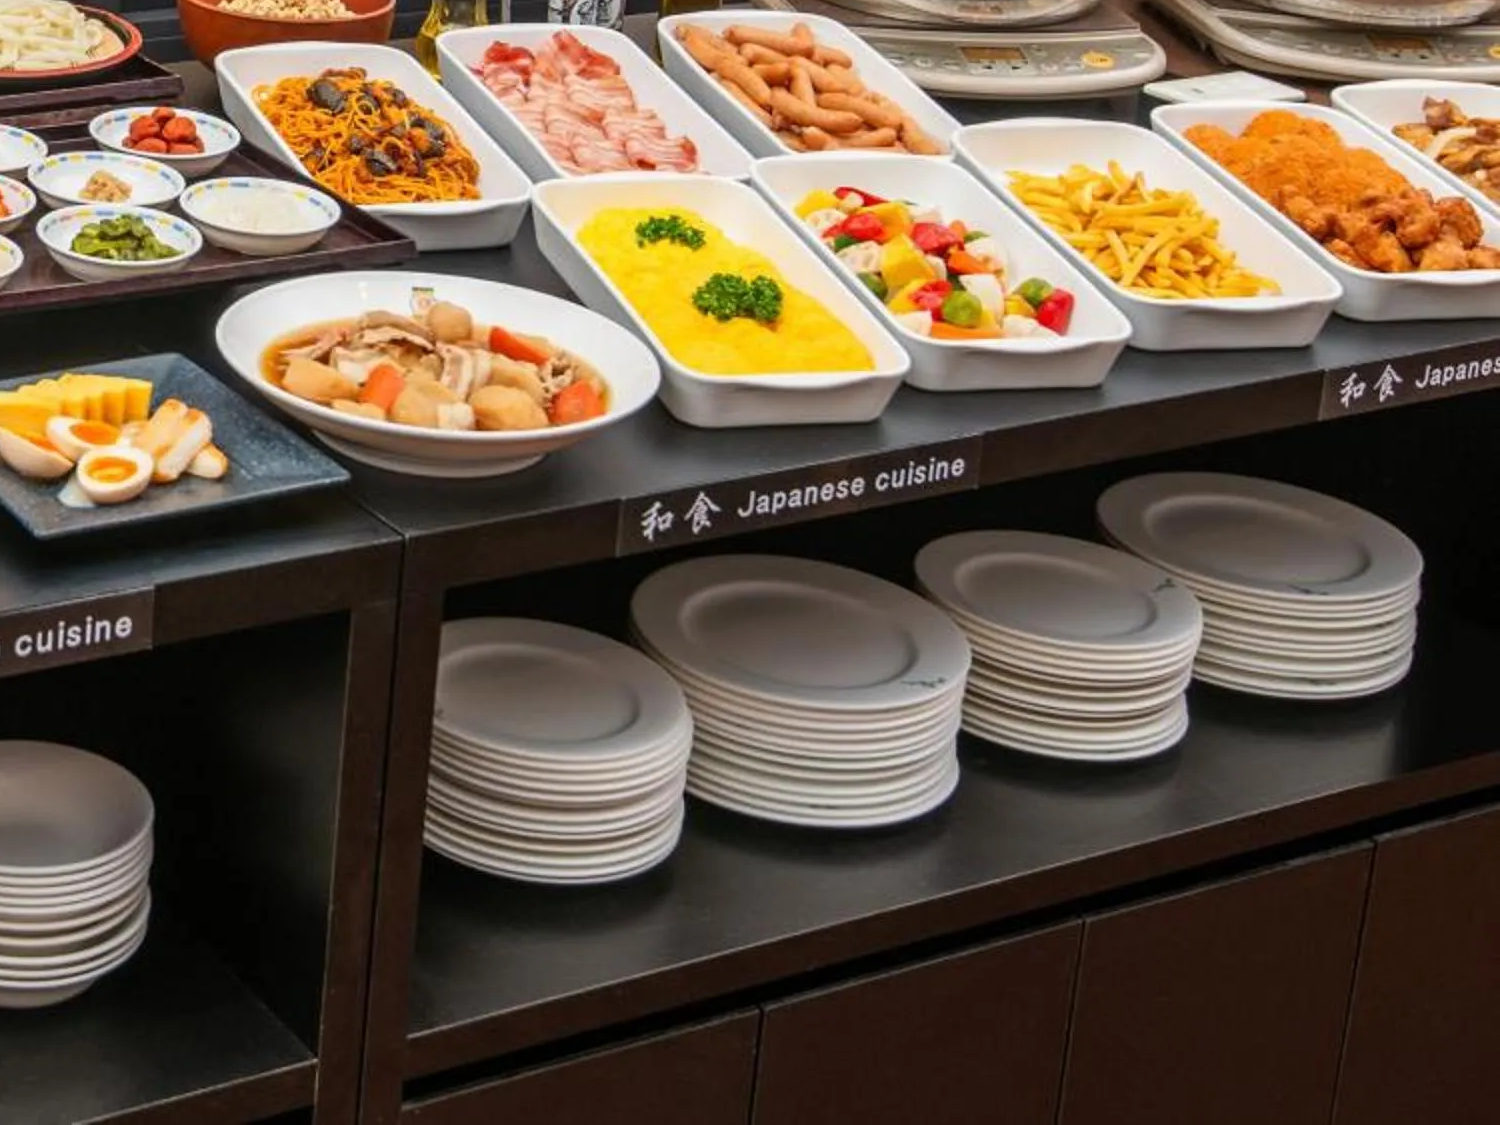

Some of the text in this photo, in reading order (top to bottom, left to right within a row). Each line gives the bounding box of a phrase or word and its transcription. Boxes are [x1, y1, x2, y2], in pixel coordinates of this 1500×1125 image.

[1339, 363, 1404, 409] 和食
[640, 457, 966, 541] 和食 Japanese cuisine
[14, 614, 134, 658] cuisine
